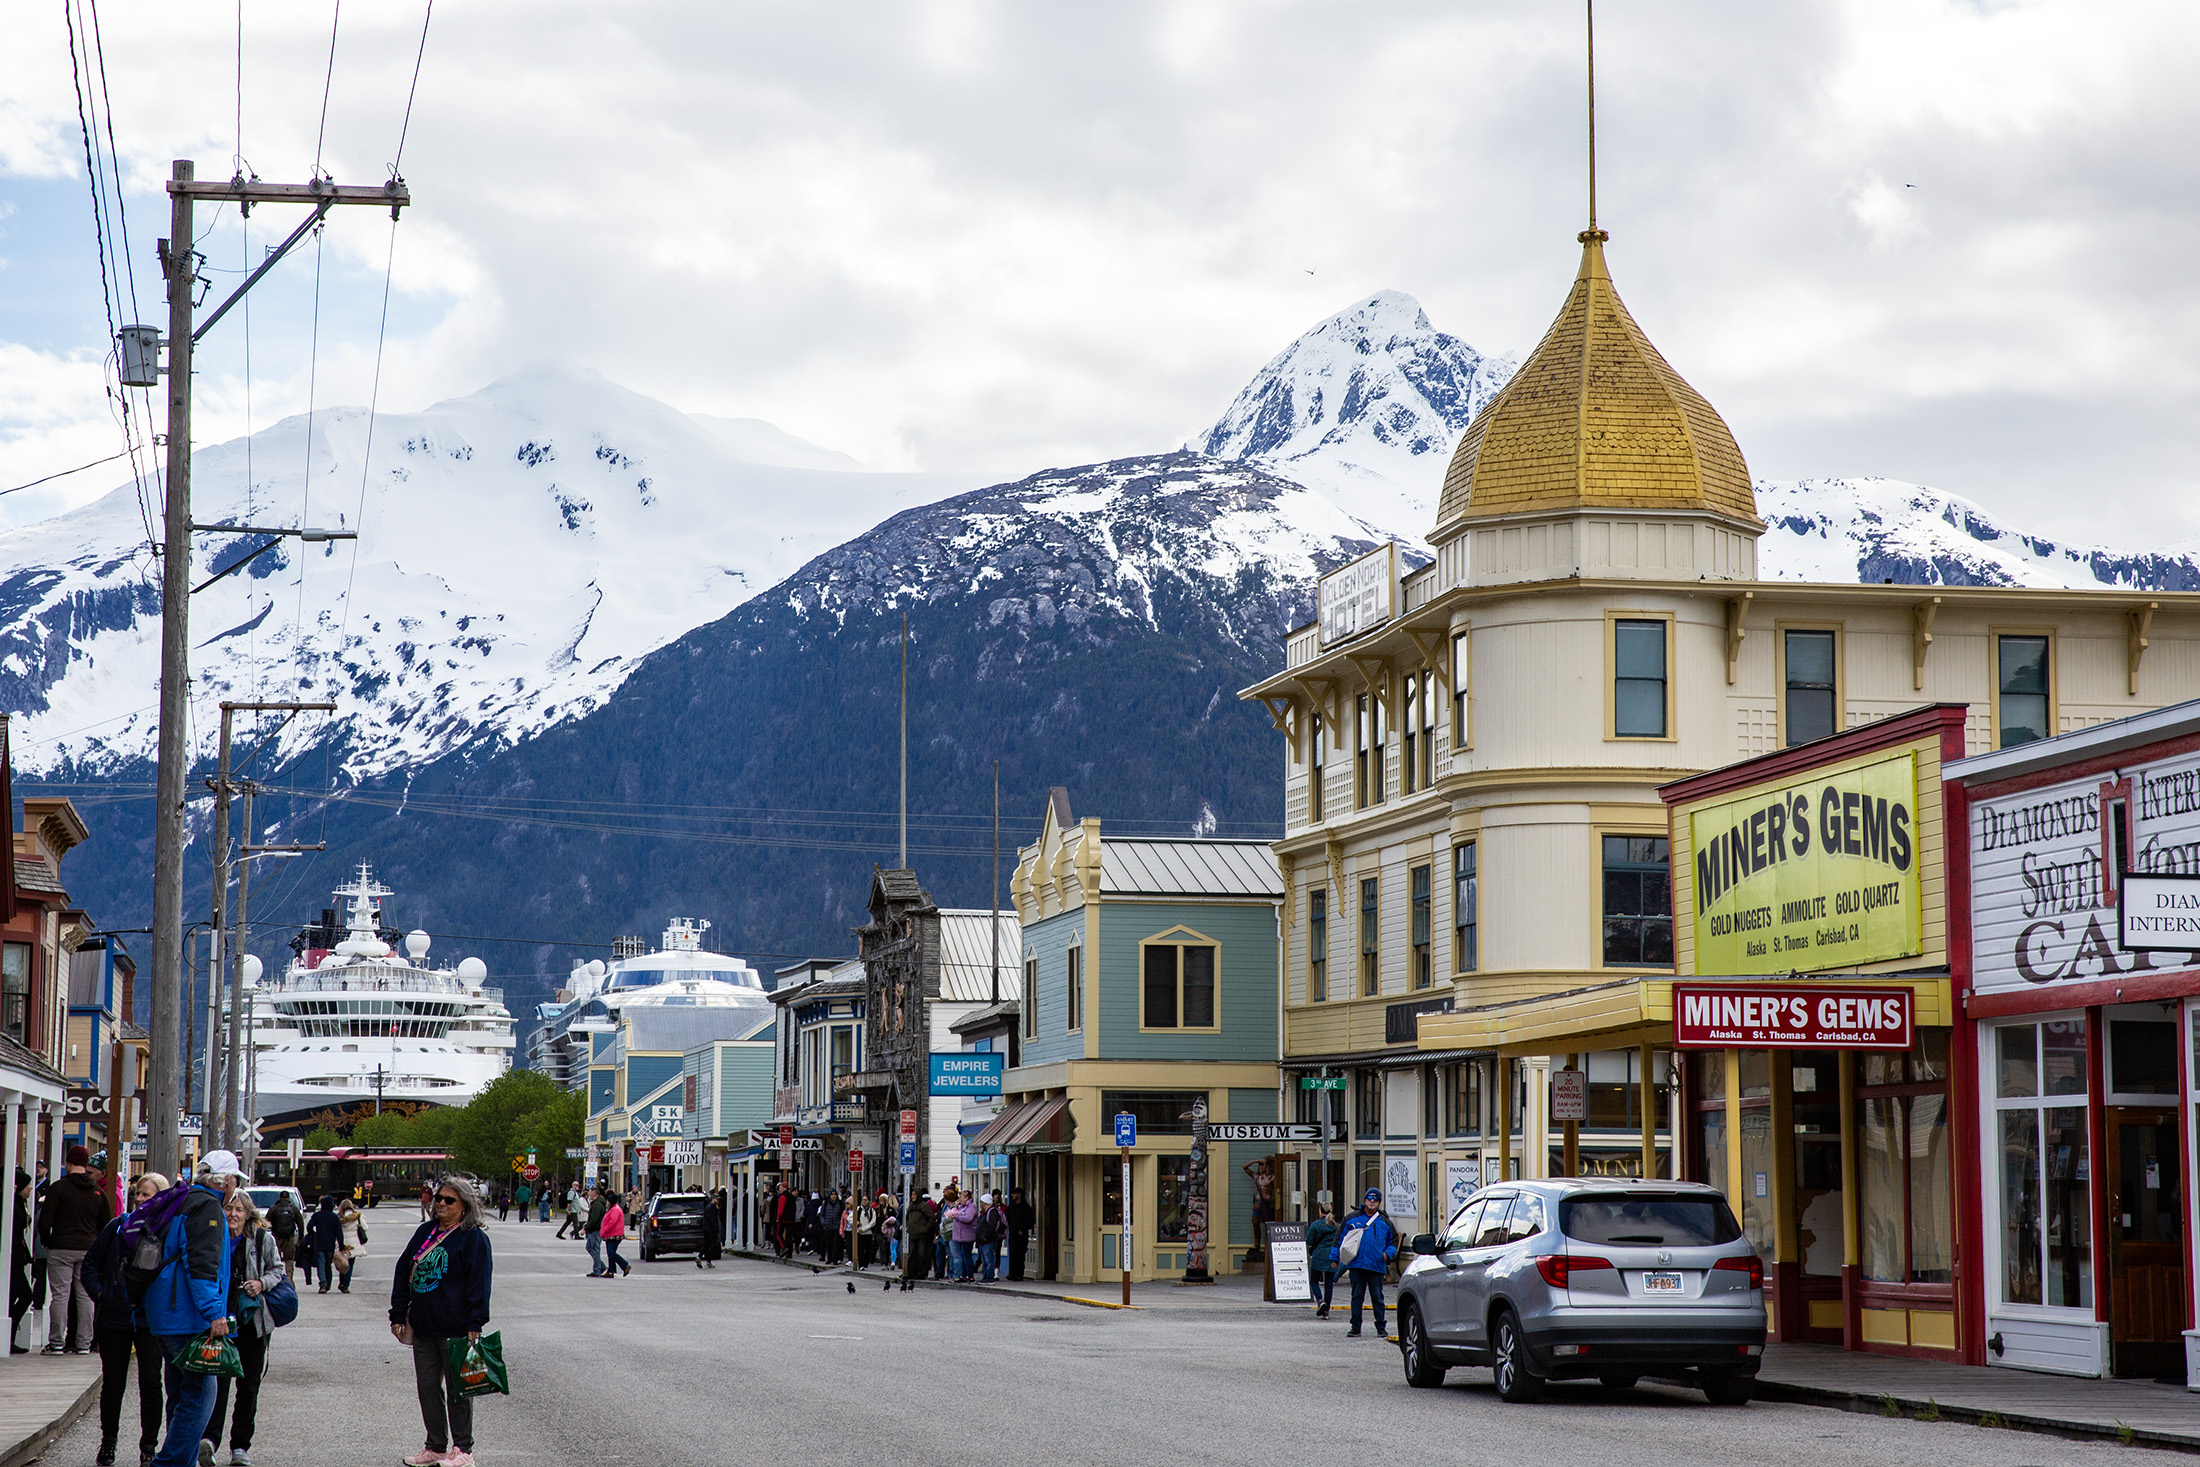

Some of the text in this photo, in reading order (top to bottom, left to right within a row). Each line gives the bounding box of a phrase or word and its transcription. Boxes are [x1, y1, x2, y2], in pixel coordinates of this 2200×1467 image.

[1357, 555, 1388, 591] NORTH
[1321, 585, 1389, 643] HOTEL
[1981, 768, 2200, 851] DIAMONDS INTER
[1697, 785, 1912, 917] MINER'S GEMS
[1711, 881, 1900, 937] GOLD NUGGETS AMMOLITE GOLD QUARTZ
[1746, 923, 1860, 957] Alaska St. Thomas Carlsbad, CA
[2014, 912, 2200, 985] CA
[1684, 995, 1902, 1030] MINER'S GEMS
[1709, 1030, 1876, 1042] Alaska St. Thomas Carlsbad, CA
[943, 1061, 990, 1071] EMPIRE
[933, 1076, 999, 1087] JEWELERS
[1324, 1080, 1338, 1088] AVE
[1208, 1126, 1290, 1138] MUSEUM
[673, 1141, 696, 1152] THE
[768, 1139, 819, 1149] AORA
[668, 1153, 699, 1164] LOOM
[1274, 1226, 1301, 1234] OMNI
